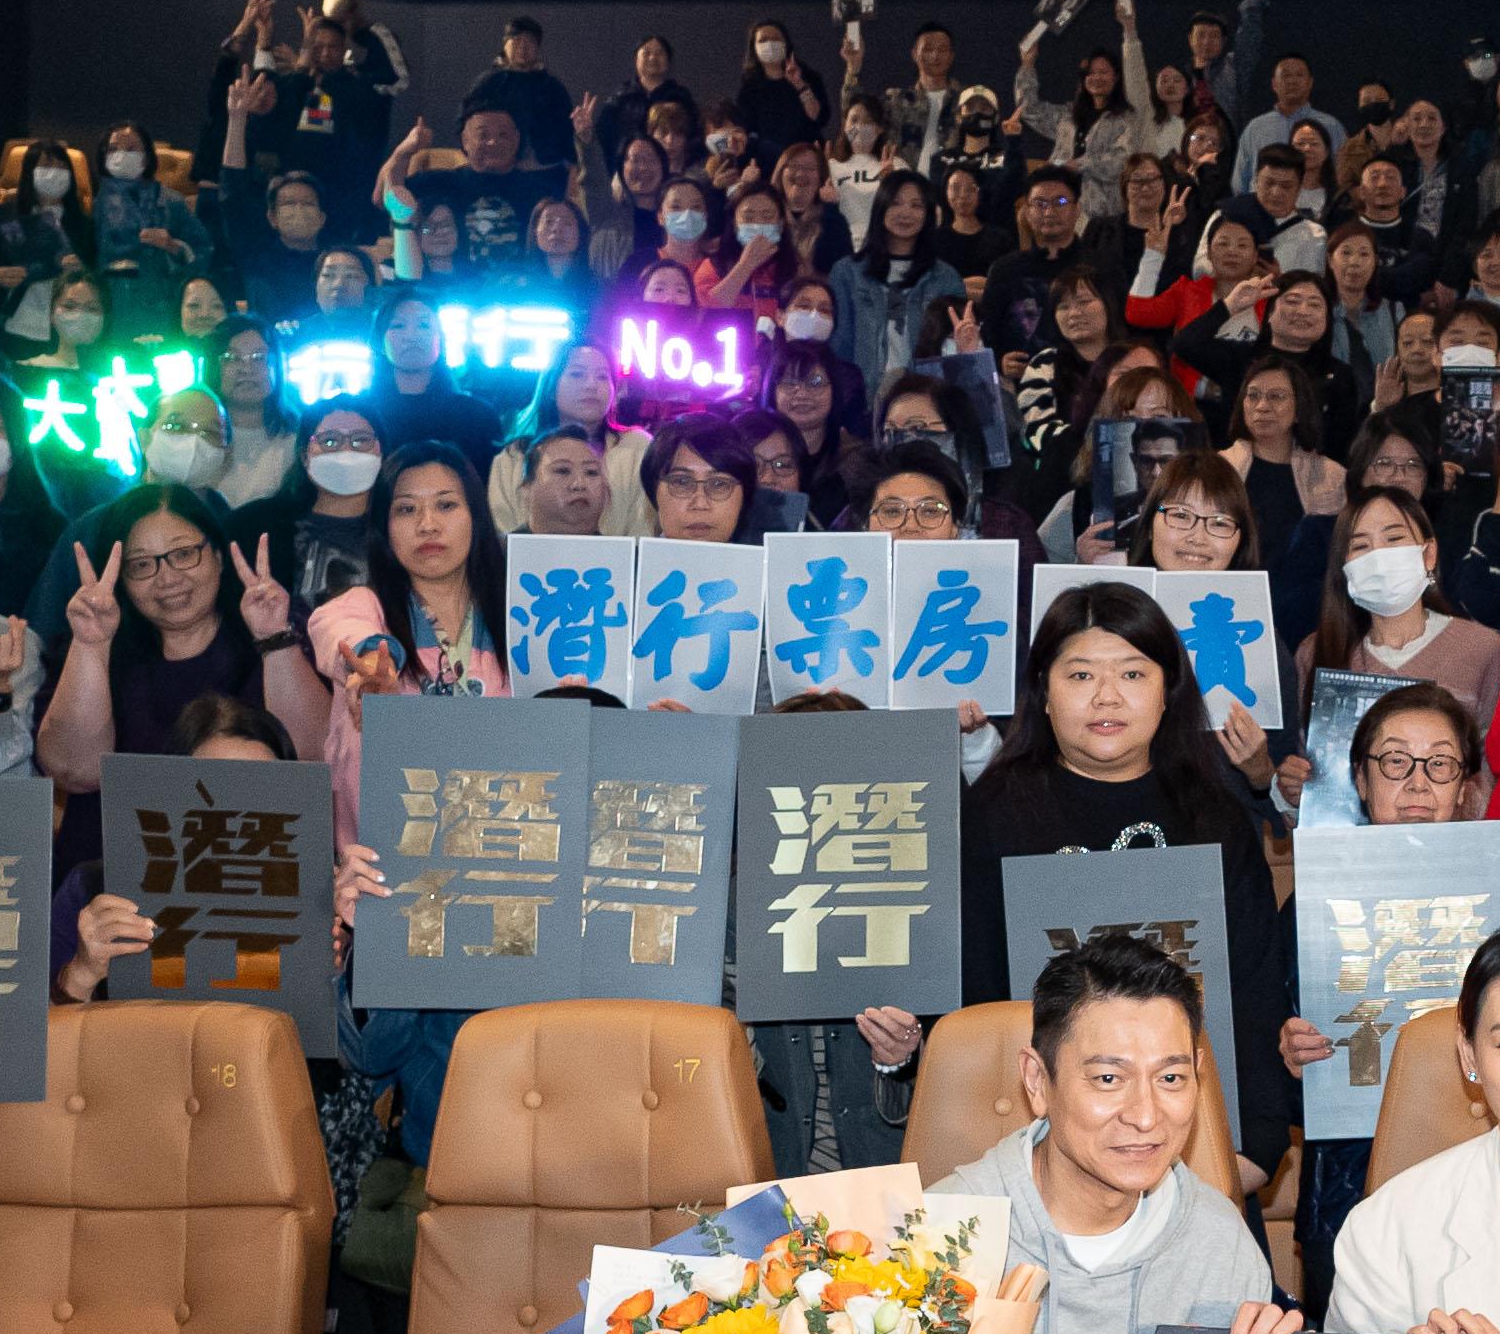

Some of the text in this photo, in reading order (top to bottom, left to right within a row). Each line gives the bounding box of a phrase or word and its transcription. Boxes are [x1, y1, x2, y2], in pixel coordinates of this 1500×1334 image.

[620, 319, 744, 388] No.1
[394, 768, 562, 958] 潛行
[766, 781, 932, 973] 潛行
[211, 1063, 237, 1088] 18
[674, 1059, 701, 1084] 17
